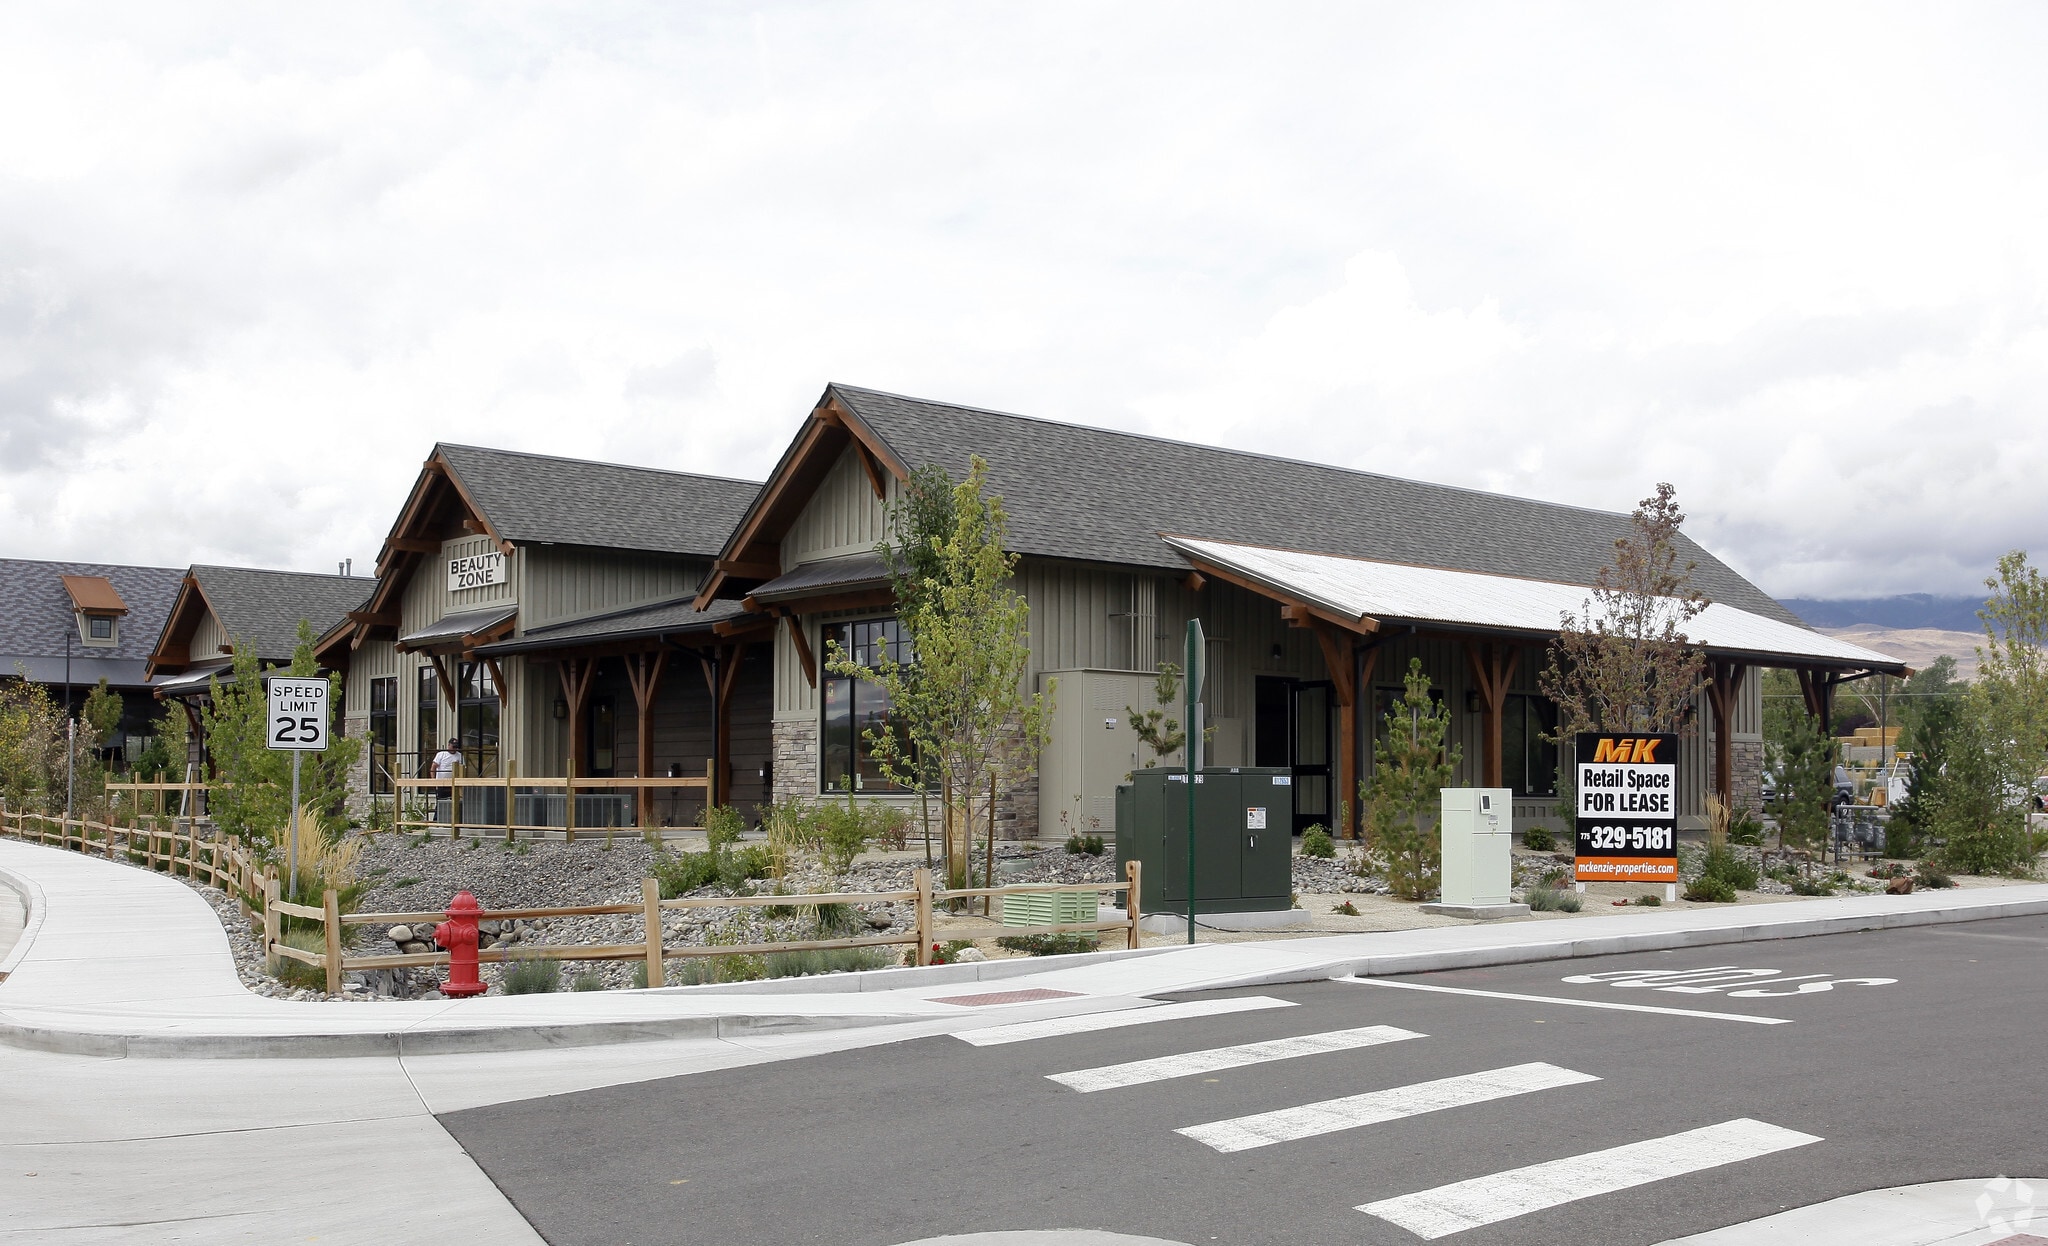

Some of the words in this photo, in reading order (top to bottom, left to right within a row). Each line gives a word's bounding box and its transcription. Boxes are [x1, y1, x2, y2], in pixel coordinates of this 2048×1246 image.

[451, 553, 501, 574] BEAUTY
[458, 569, 493, 587] ZONE
[274, 686, 323, 697] SPEED
[280, 701, 317, 712] LIMIT
[275, 716, 319, 742] 25
[1584, 769, 1623, 787] Retail
[1627, 769, 1669, 791] Space
[1584, 793, 1614, 811] FOR
[1620, 793, 1669, 812] LEASE
[1580, 832, 1590, 840] 775
[1591, 826, 1672, 849] 329-5181
[1578, 861, 1674, 875] mckenzie-properties.com
